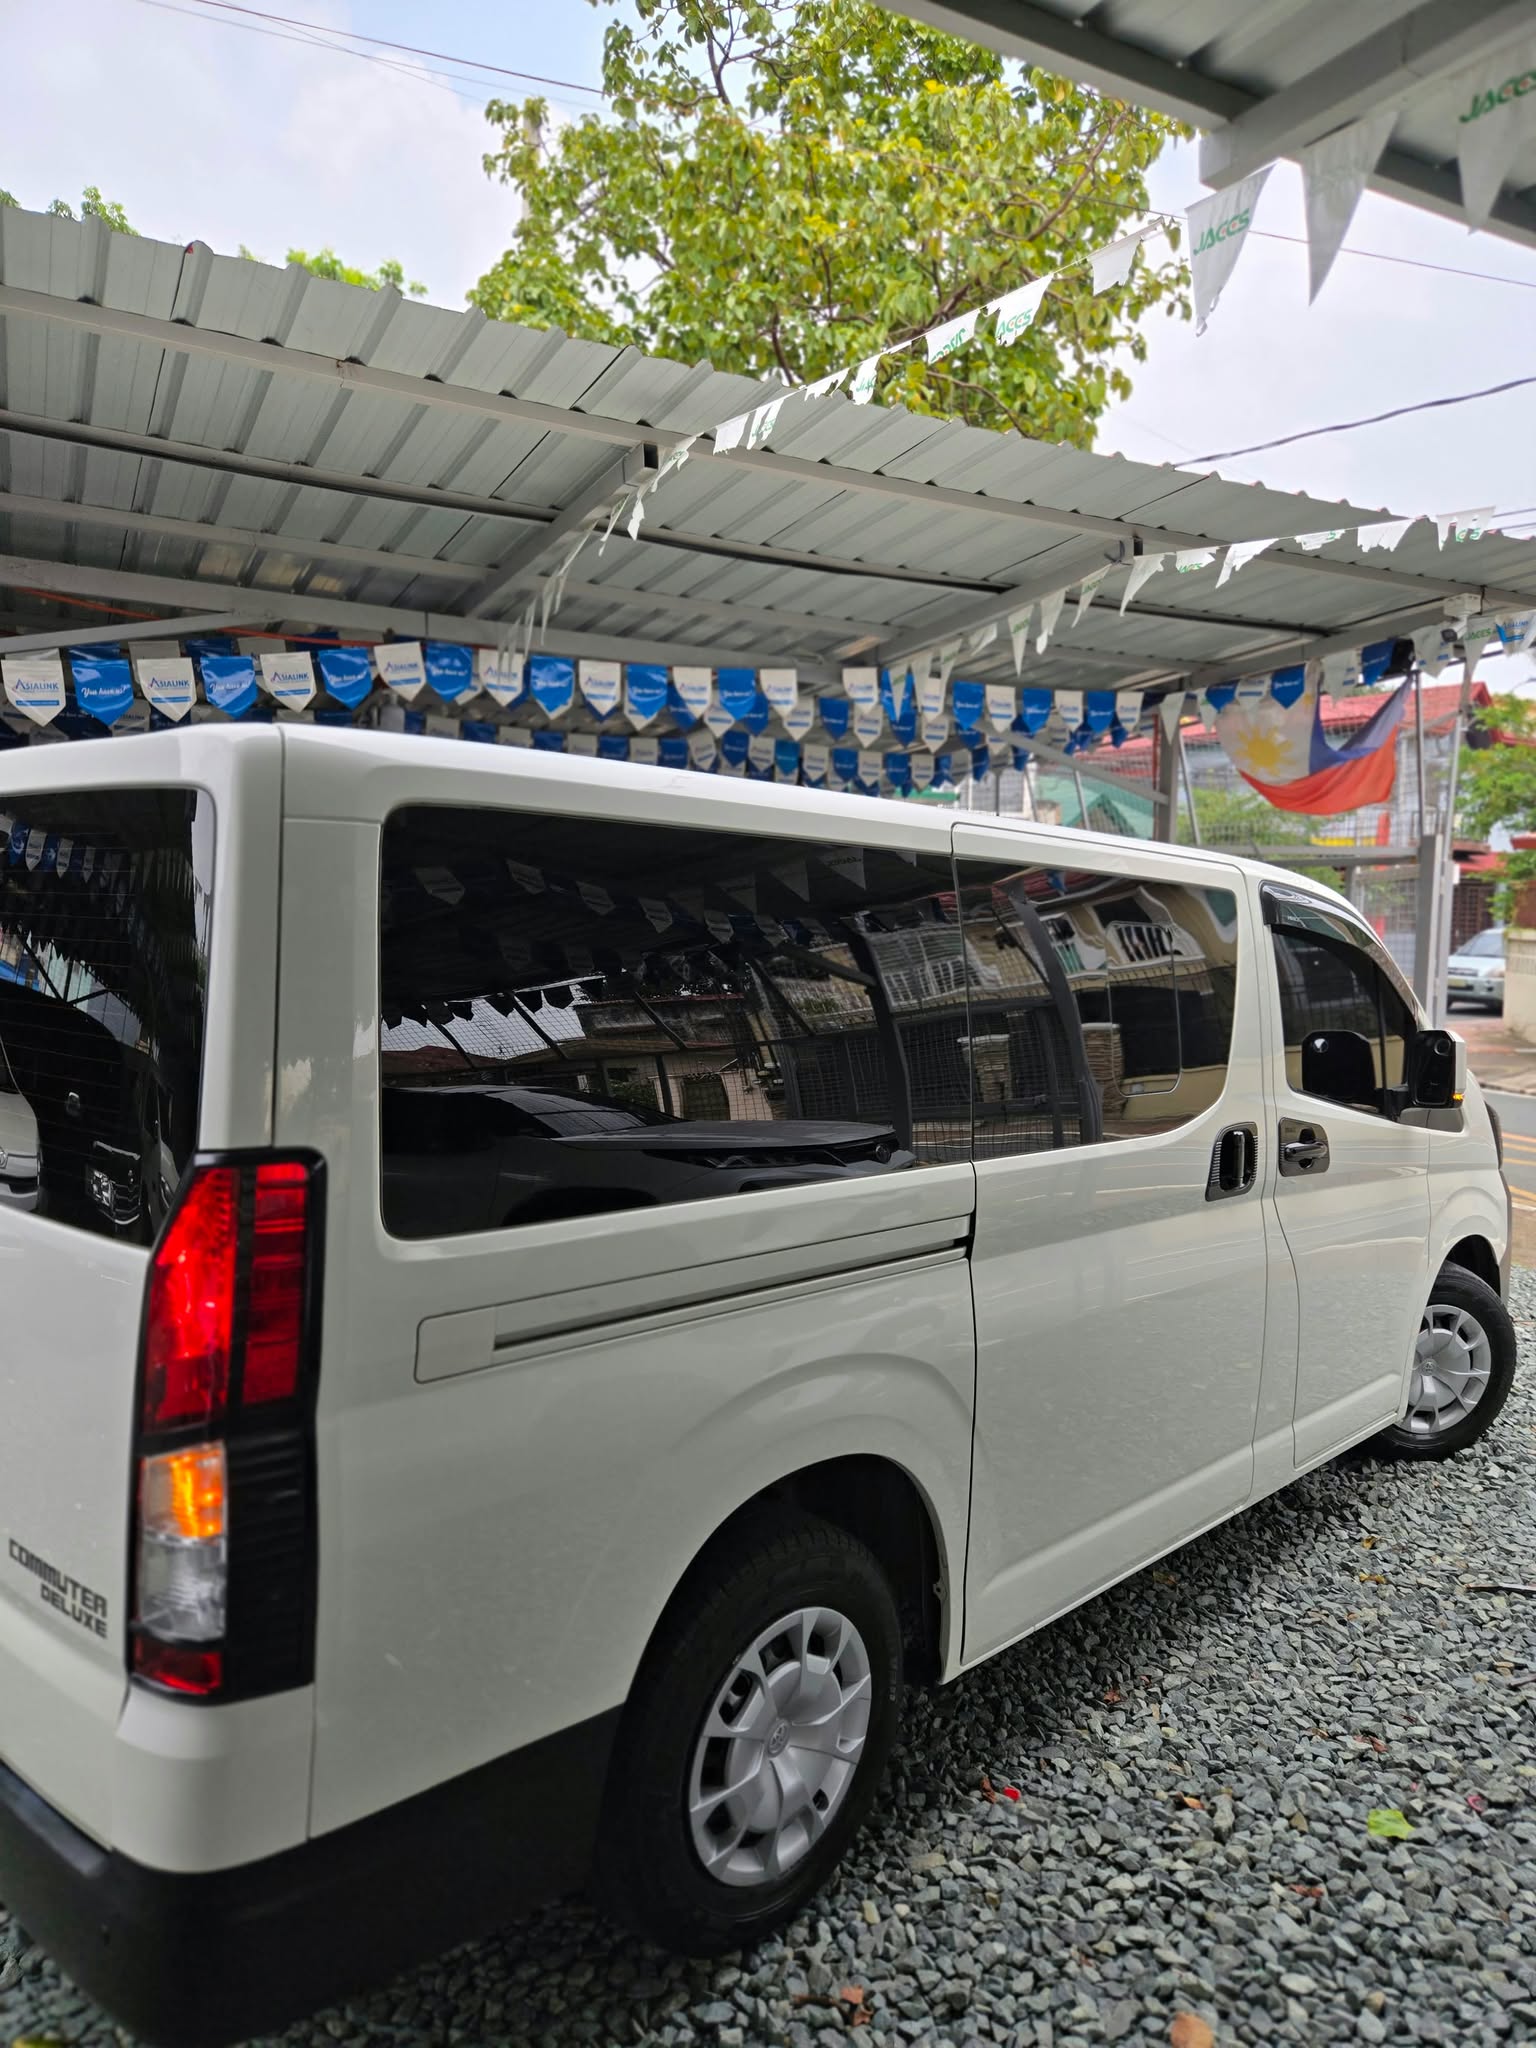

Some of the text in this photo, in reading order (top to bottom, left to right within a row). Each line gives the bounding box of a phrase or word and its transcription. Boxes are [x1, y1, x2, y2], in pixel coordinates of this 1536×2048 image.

[1193, 208, 1250, 256] JACCS
[995, 308, 1033, 338] ACCS
[13, 679, 60, 691] ASIALINK
[148, 677, 190, 688] ASIALINK
[9, 1537, 107, 1618] COMMUTER
[41, 1583, 107, 1639] DELUXE
